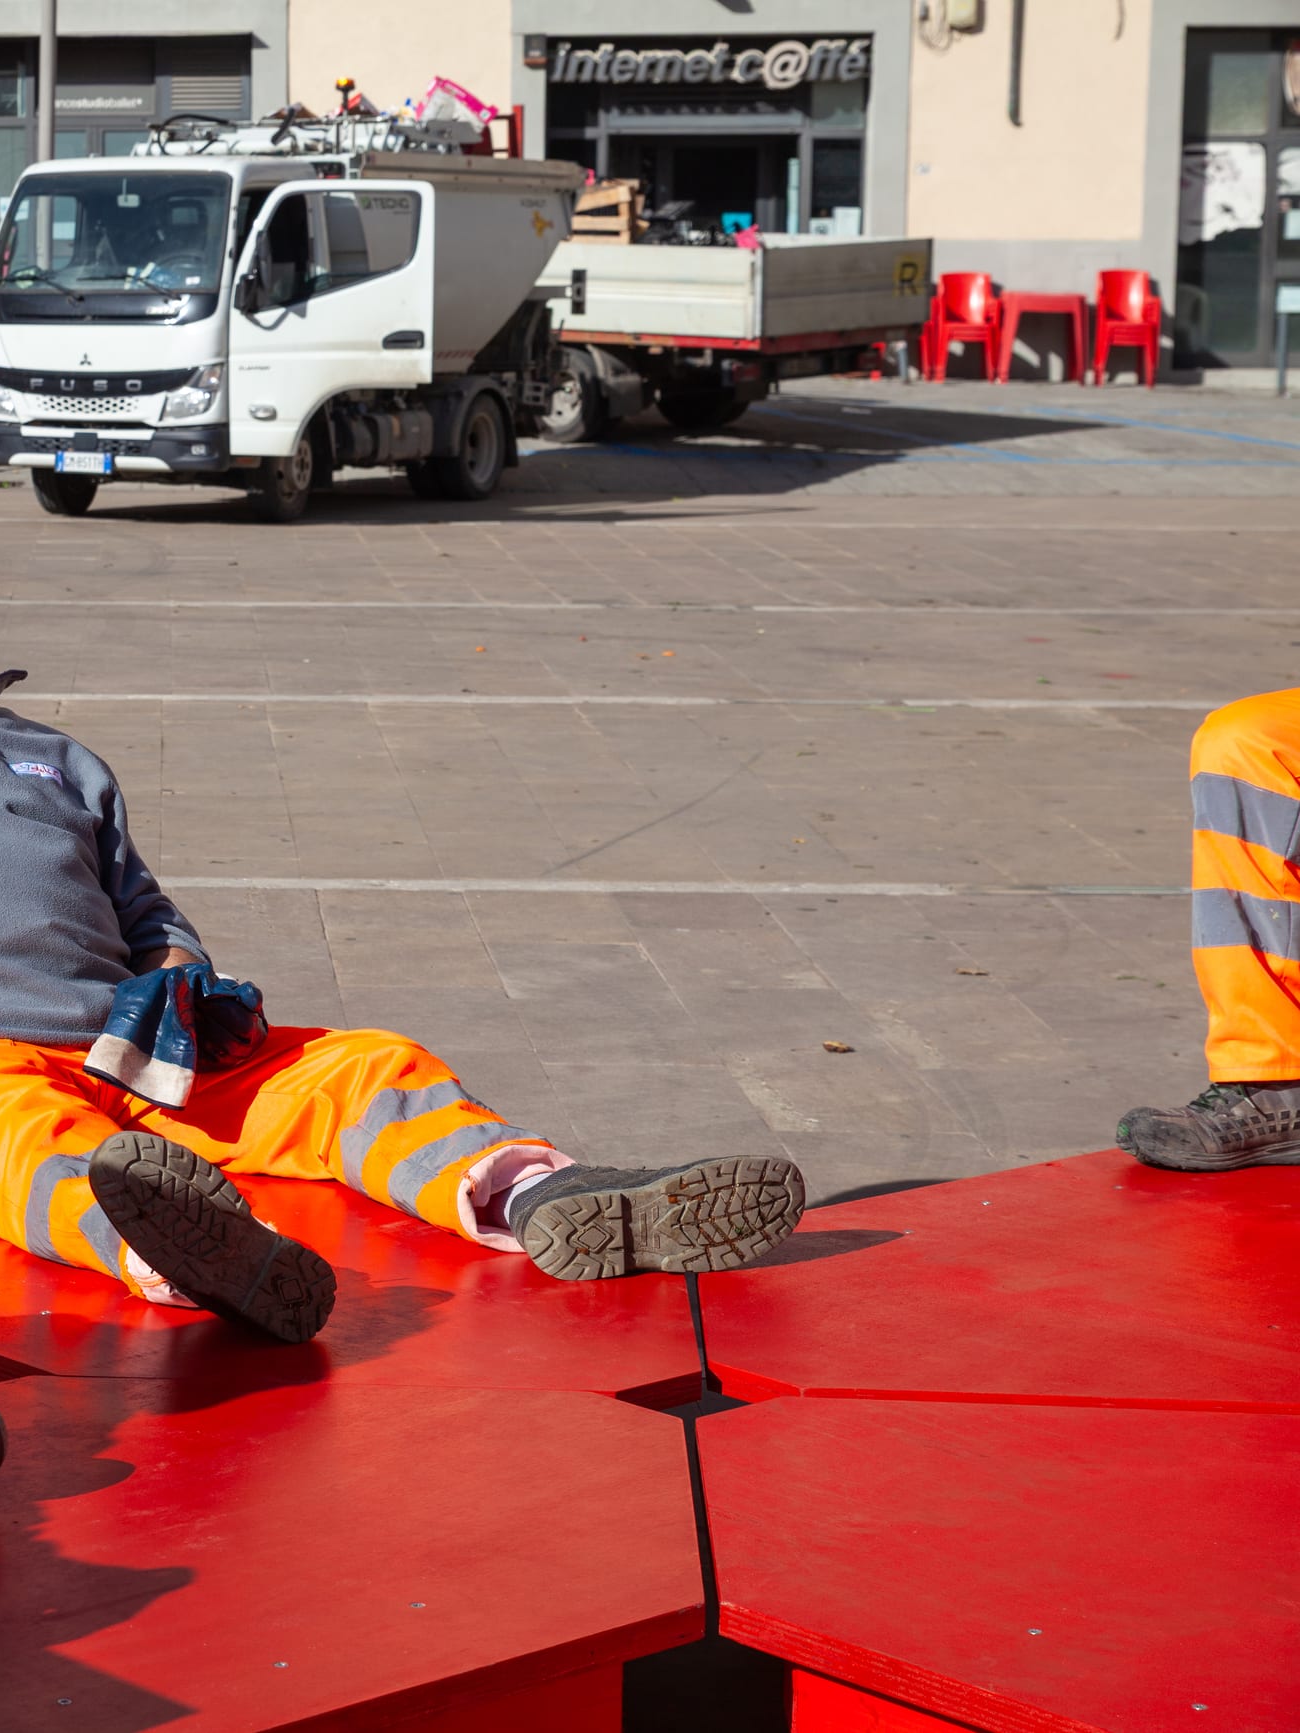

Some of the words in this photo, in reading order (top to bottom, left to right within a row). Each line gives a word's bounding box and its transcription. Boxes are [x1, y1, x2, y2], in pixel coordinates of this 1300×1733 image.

[551, 43, 729, 84] internet
[899, 262, 918, 297] R
[29, 377, 142, 393] FUSO
